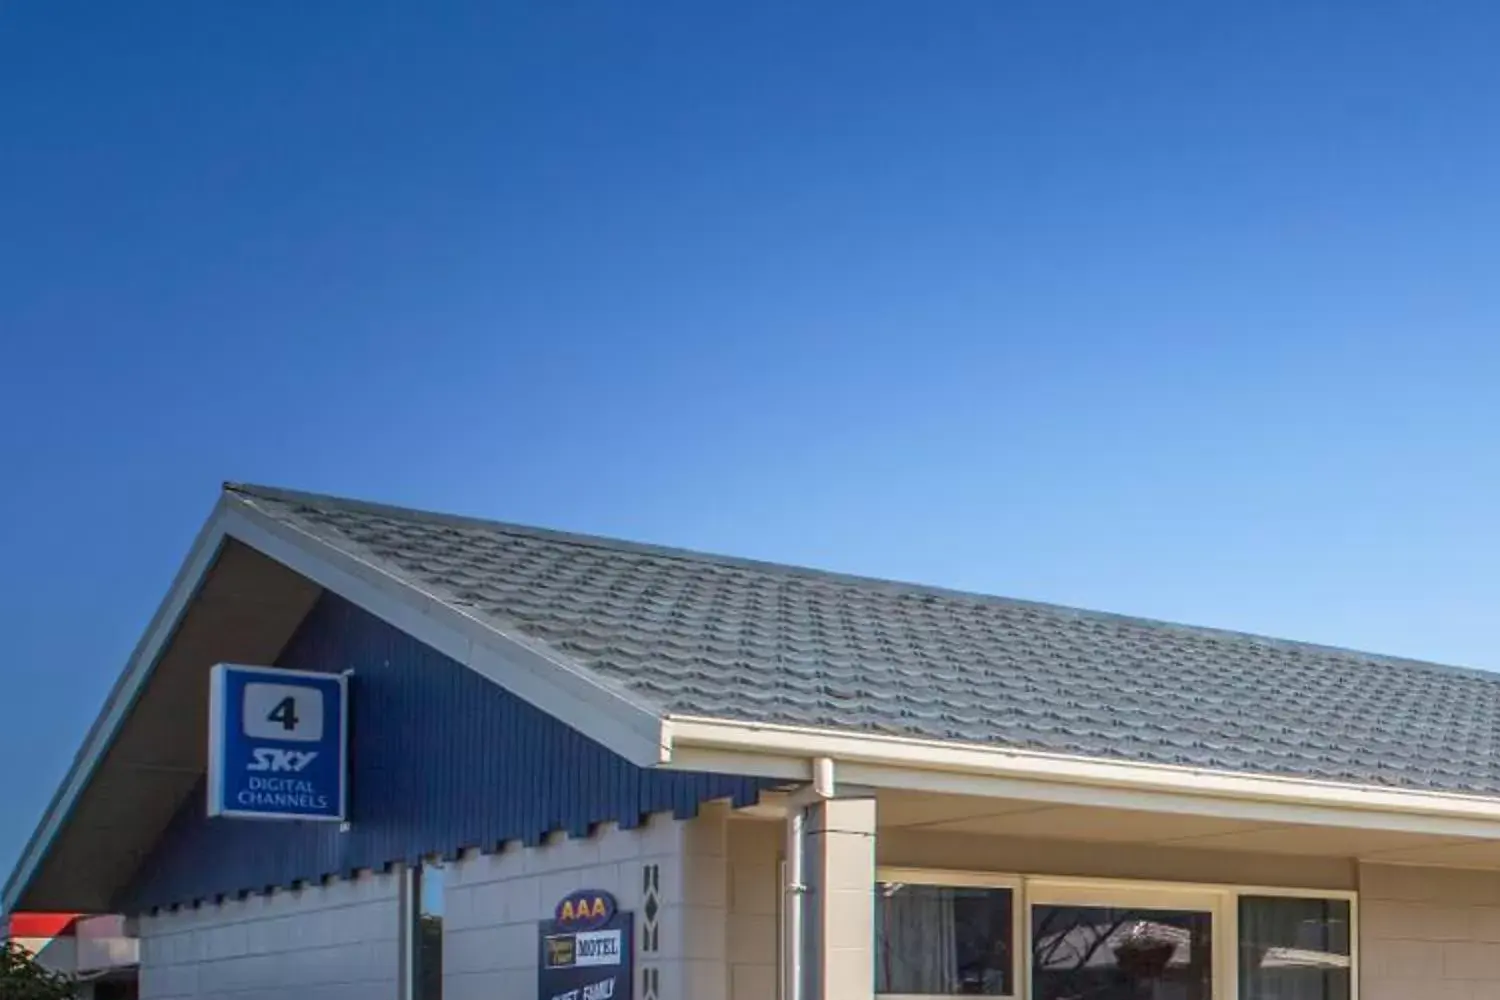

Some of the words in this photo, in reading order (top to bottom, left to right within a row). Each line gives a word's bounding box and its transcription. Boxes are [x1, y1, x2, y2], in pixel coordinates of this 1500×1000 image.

[266, 696, 299, 731] 4
[246, 748, 320, 772] SKY
[249, 776, 315, 794] DIGITAL
[238, 790, 330, 809] CHANNELS
[577, 936, 618, 957] MOTEL
